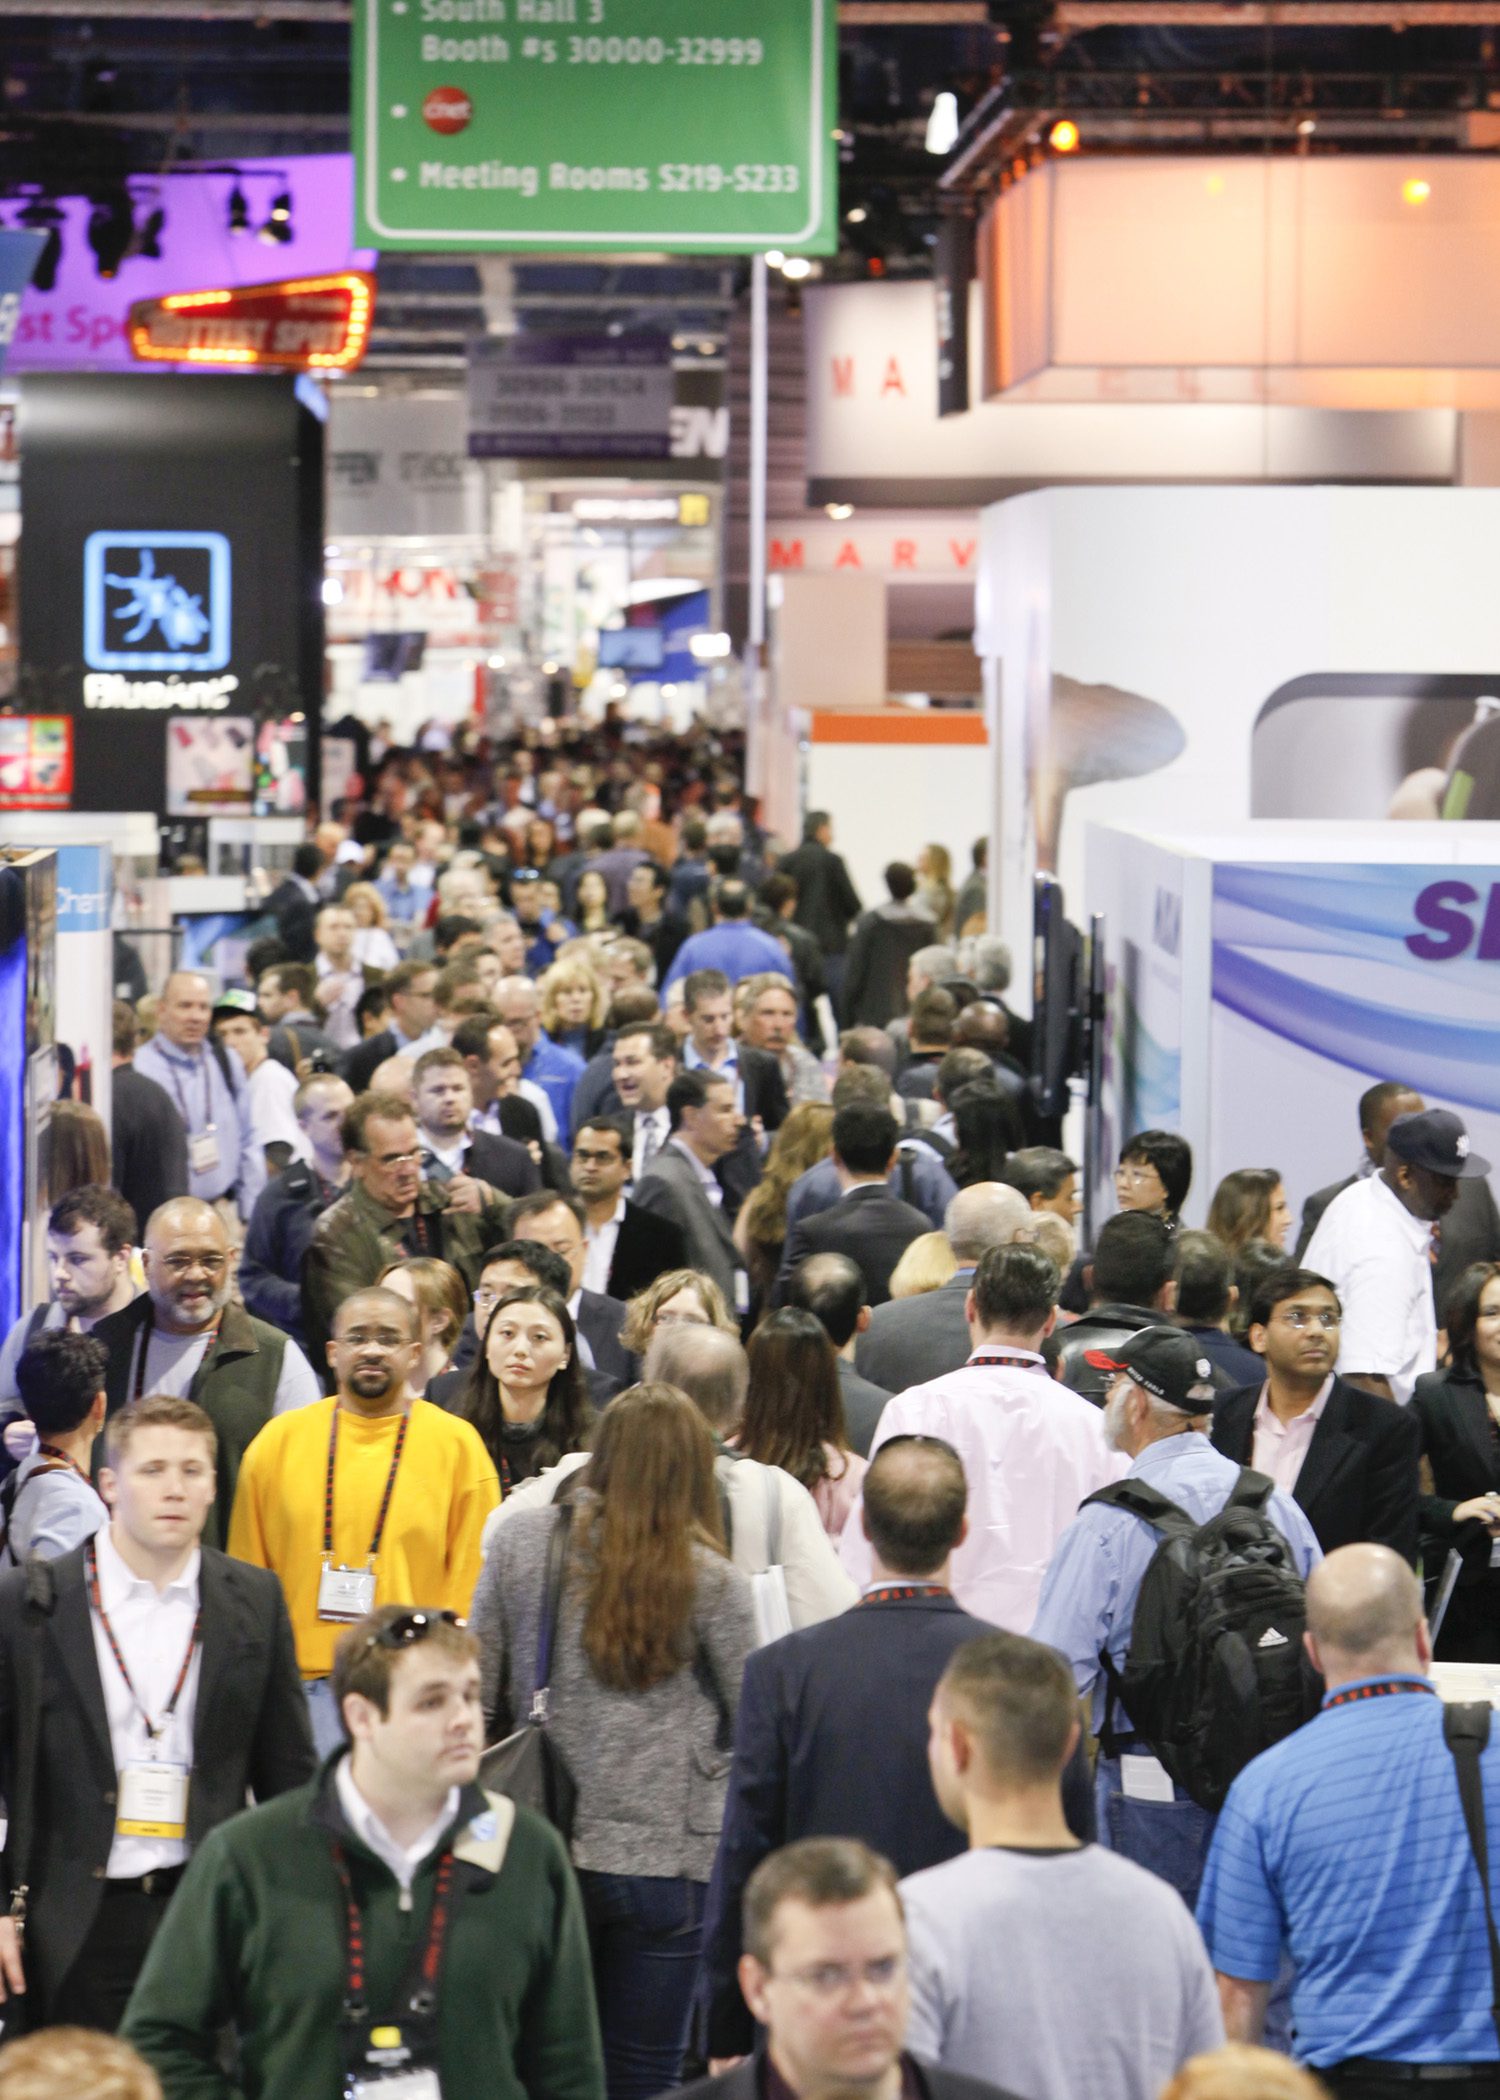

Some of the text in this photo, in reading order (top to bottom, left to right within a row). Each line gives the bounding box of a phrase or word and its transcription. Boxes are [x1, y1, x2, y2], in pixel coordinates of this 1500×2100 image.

[421, 0, 507, 23] South
[516, 0, 577, 23] Hall
[421, 34, 510, 63] Booth
[567, 36, 765, 65] 30000-32999
[419, 158, 800, 198] Meeting Rooms S219-S233
